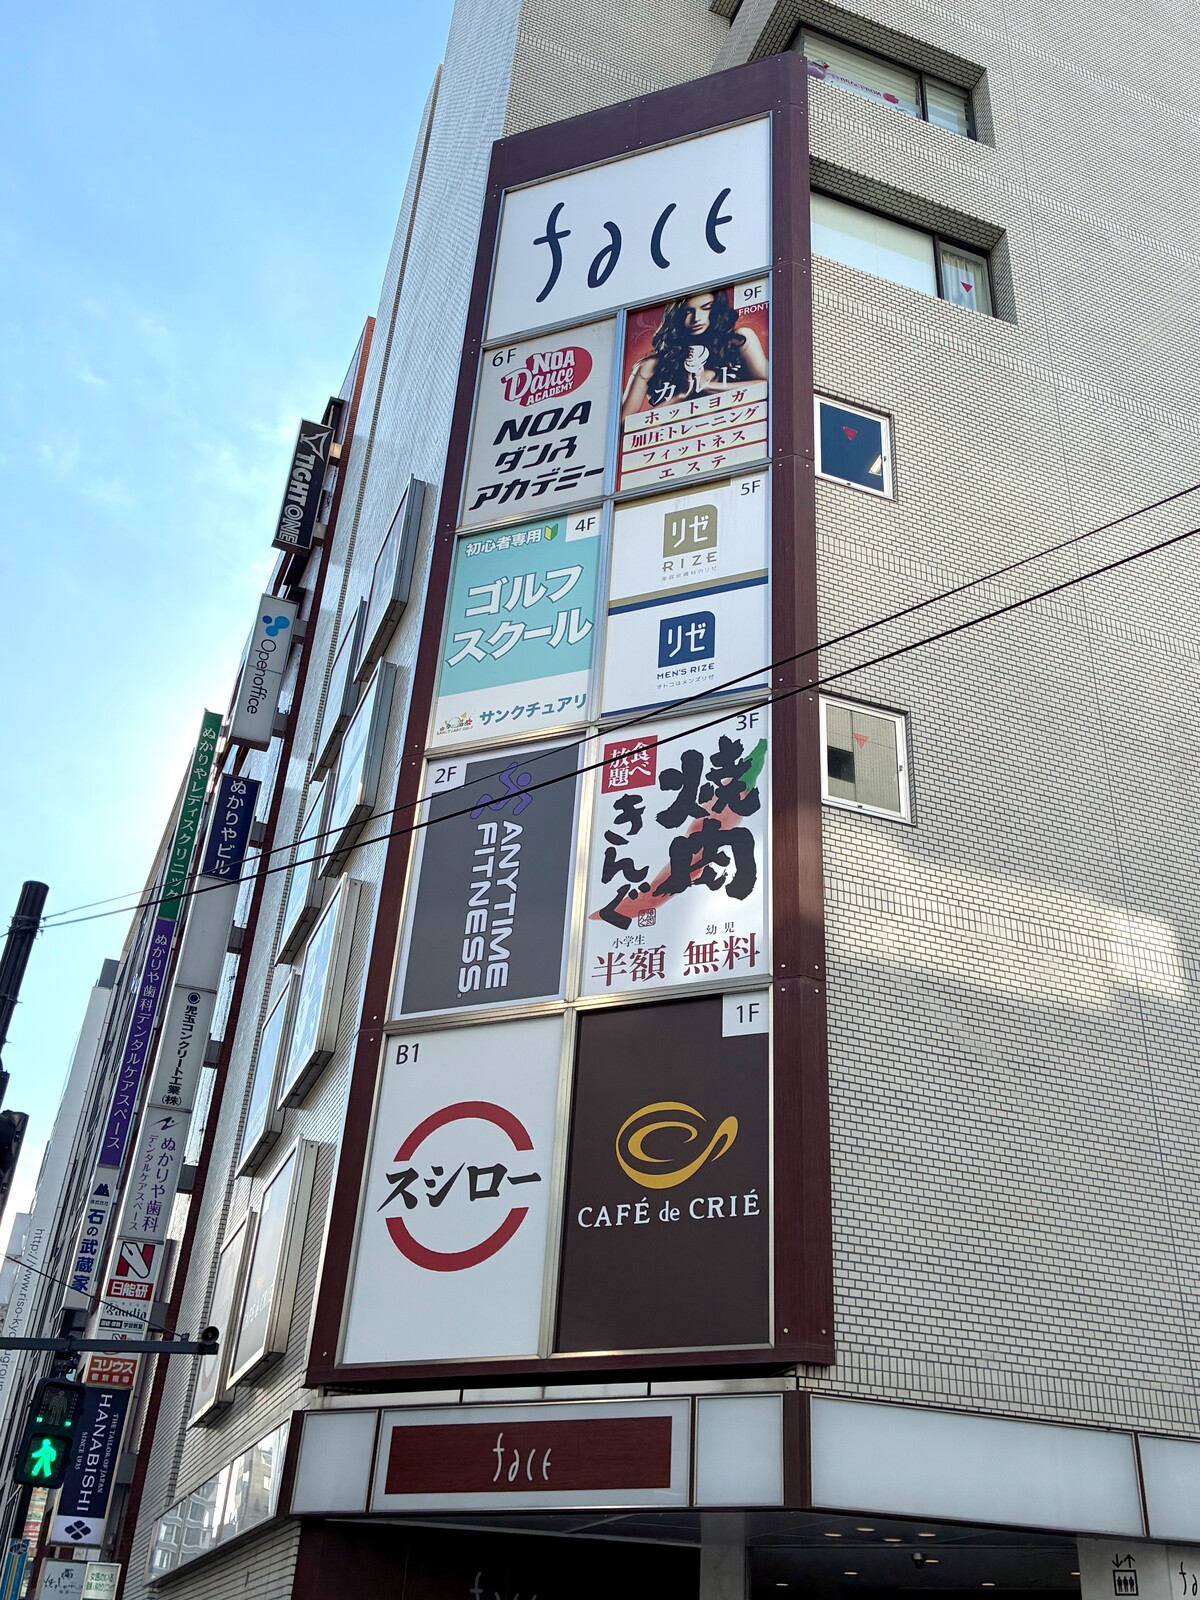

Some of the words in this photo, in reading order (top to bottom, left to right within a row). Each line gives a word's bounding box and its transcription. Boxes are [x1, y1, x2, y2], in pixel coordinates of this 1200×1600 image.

[533, 188, 733, 303] face
[738, 303, 768, 316] FRONT
[744, 286, 762, 301] 9F
[492, 348, 517, 366] 6F
[532, 350, 575, 375] NOA
[504, 367, 574, 401] Dance
[525, 381, 573, 406] ACADEMY
[654, 365, 741, 405] カルド
[493, 401, 592, 445] NOA
[645, 389, 747, 424] ホットヨガ
[631, 406, 759, 448] 加圧トレーニング
[495, 436, 578, 474] ダンス
[643, 430, 745, 463] フィットネス
[287, 452, 316, 507] TIGHT
[659, 456, 727, 480] エステ
[469, 465, 604, 511] アカデミー
[741, 480, 761, 495] 5F
[279, 504, 304, 544] ONE
[575, 517, 596, 532] 4F
[672, 514, 709, 548] リゼ
[465, 529, 542, 557] 初心者専用
[662, 551, 717, 572] RIZE
[465, 564, 584, 618] ゴルフ
[446, 607, 594, 668] スクール
[668, 622, 706, 658] リゼ
[246, 639, 277, 715] Openoffice
[657, 668, 687, 680] MEN'S
[690, 663, 715, 674] RIZE
[479, 694, 587, 726] サンクチュアリ
[736, 712, 760, 731] 3F
[434, 766, 457, 784] 2F
[628, 742, 651, 777] 食べ
[212, 780, 247, 875] ぬかりやビル
[652, 734, 761, 901] 焼肉
[599, 793, 651, 930] きんぐ
[458, 821, 498, 993] FITNESS
[485, 820, 523, 989] ANYTIME
[612, 934, 645, 949] 小学生
[683, 932, 760, 976] 無料
[591, 945, 667, 987] 半額
[736, 1003, 760, 1024] 1F
[395, 1043, 420, 1065] B1
[129, 1135, 159, 1231] デンタルケアスペース
[142, 1137, 176, 1233] ぬかりや歯科
[377, 1162, 542, 1213] スシロー
[577, 1198, 650, 1229] CAFÉ
[659, 1200, 681, 1223] de
[689, 1189, 760, 1221] CRIÉ
[72, 1208, 106, 1292] 石の武蔵家
[111, 1281, 149, 1299] 日能研
[91, 1359, 134, 1374] ユリウス
[77, 1393, 113, 1512] HANABISHI
[78, 1431, 88, 1453] SINCE
[493, 1432, 552, 1481] face
